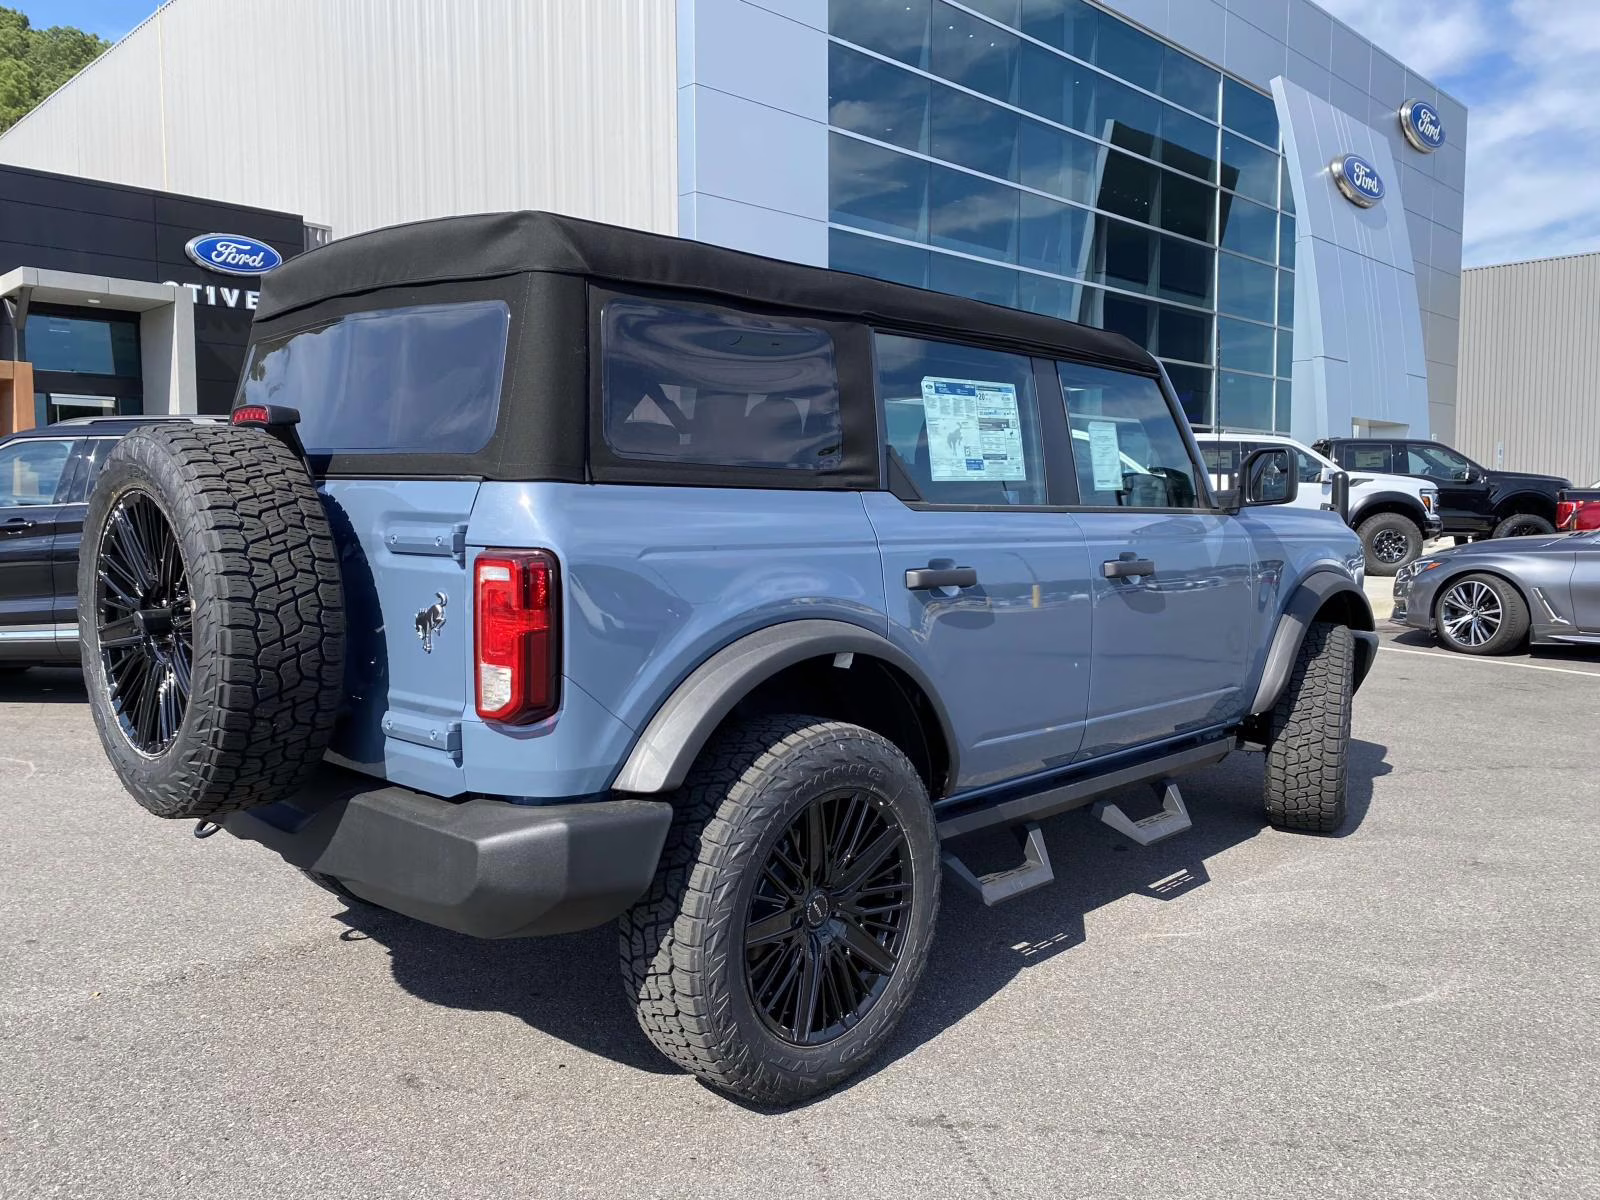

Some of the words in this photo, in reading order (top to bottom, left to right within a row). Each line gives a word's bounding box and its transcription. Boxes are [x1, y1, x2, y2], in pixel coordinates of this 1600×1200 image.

[1418, 109, 1440, 142] Ford
[1354, 162, 1378, 193] Ford
[211, 241, 264, 267] Ford
[162, 280, 260, 310] TIVE
